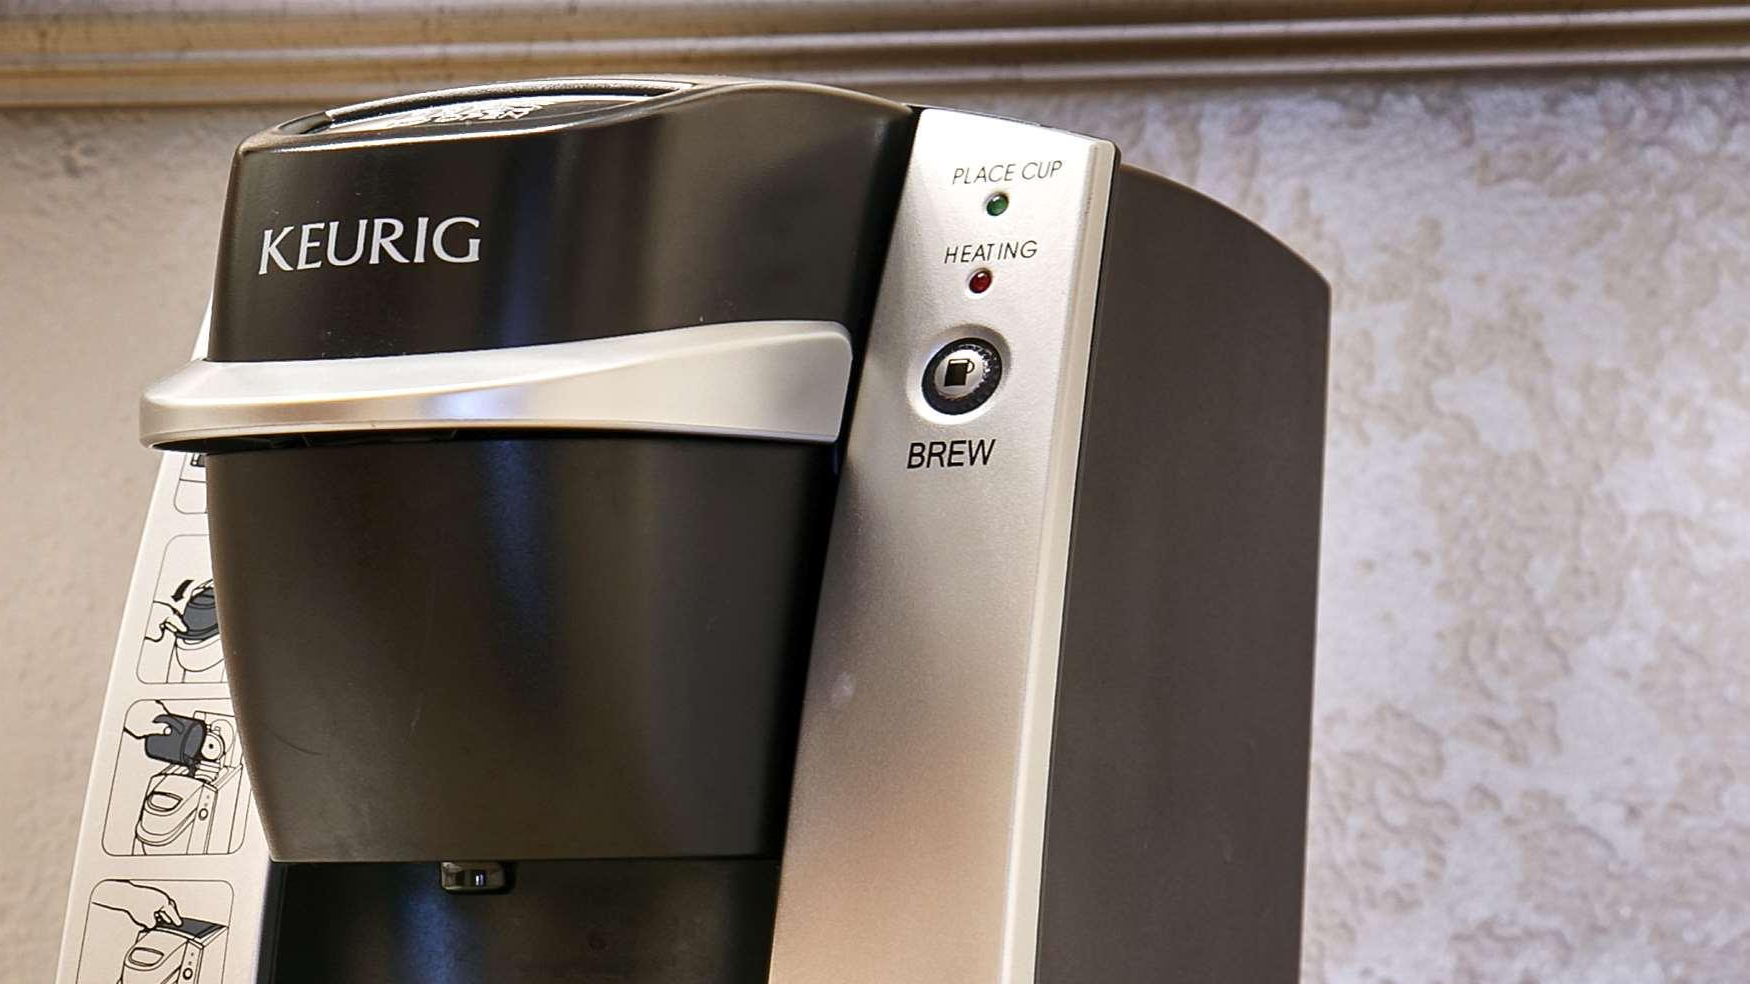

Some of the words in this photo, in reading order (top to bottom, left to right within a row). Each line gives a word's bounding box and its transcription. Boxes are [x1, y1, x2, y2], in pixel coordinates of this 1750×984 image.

[952, 162, 1015, 185] PLACE
[1021, 160, 1064, 182] CUP
[258, 216, 481, 275] KEURIG
[944, 240, 1038, 265] HEATING
[906, 438, 996, 470] BREW
